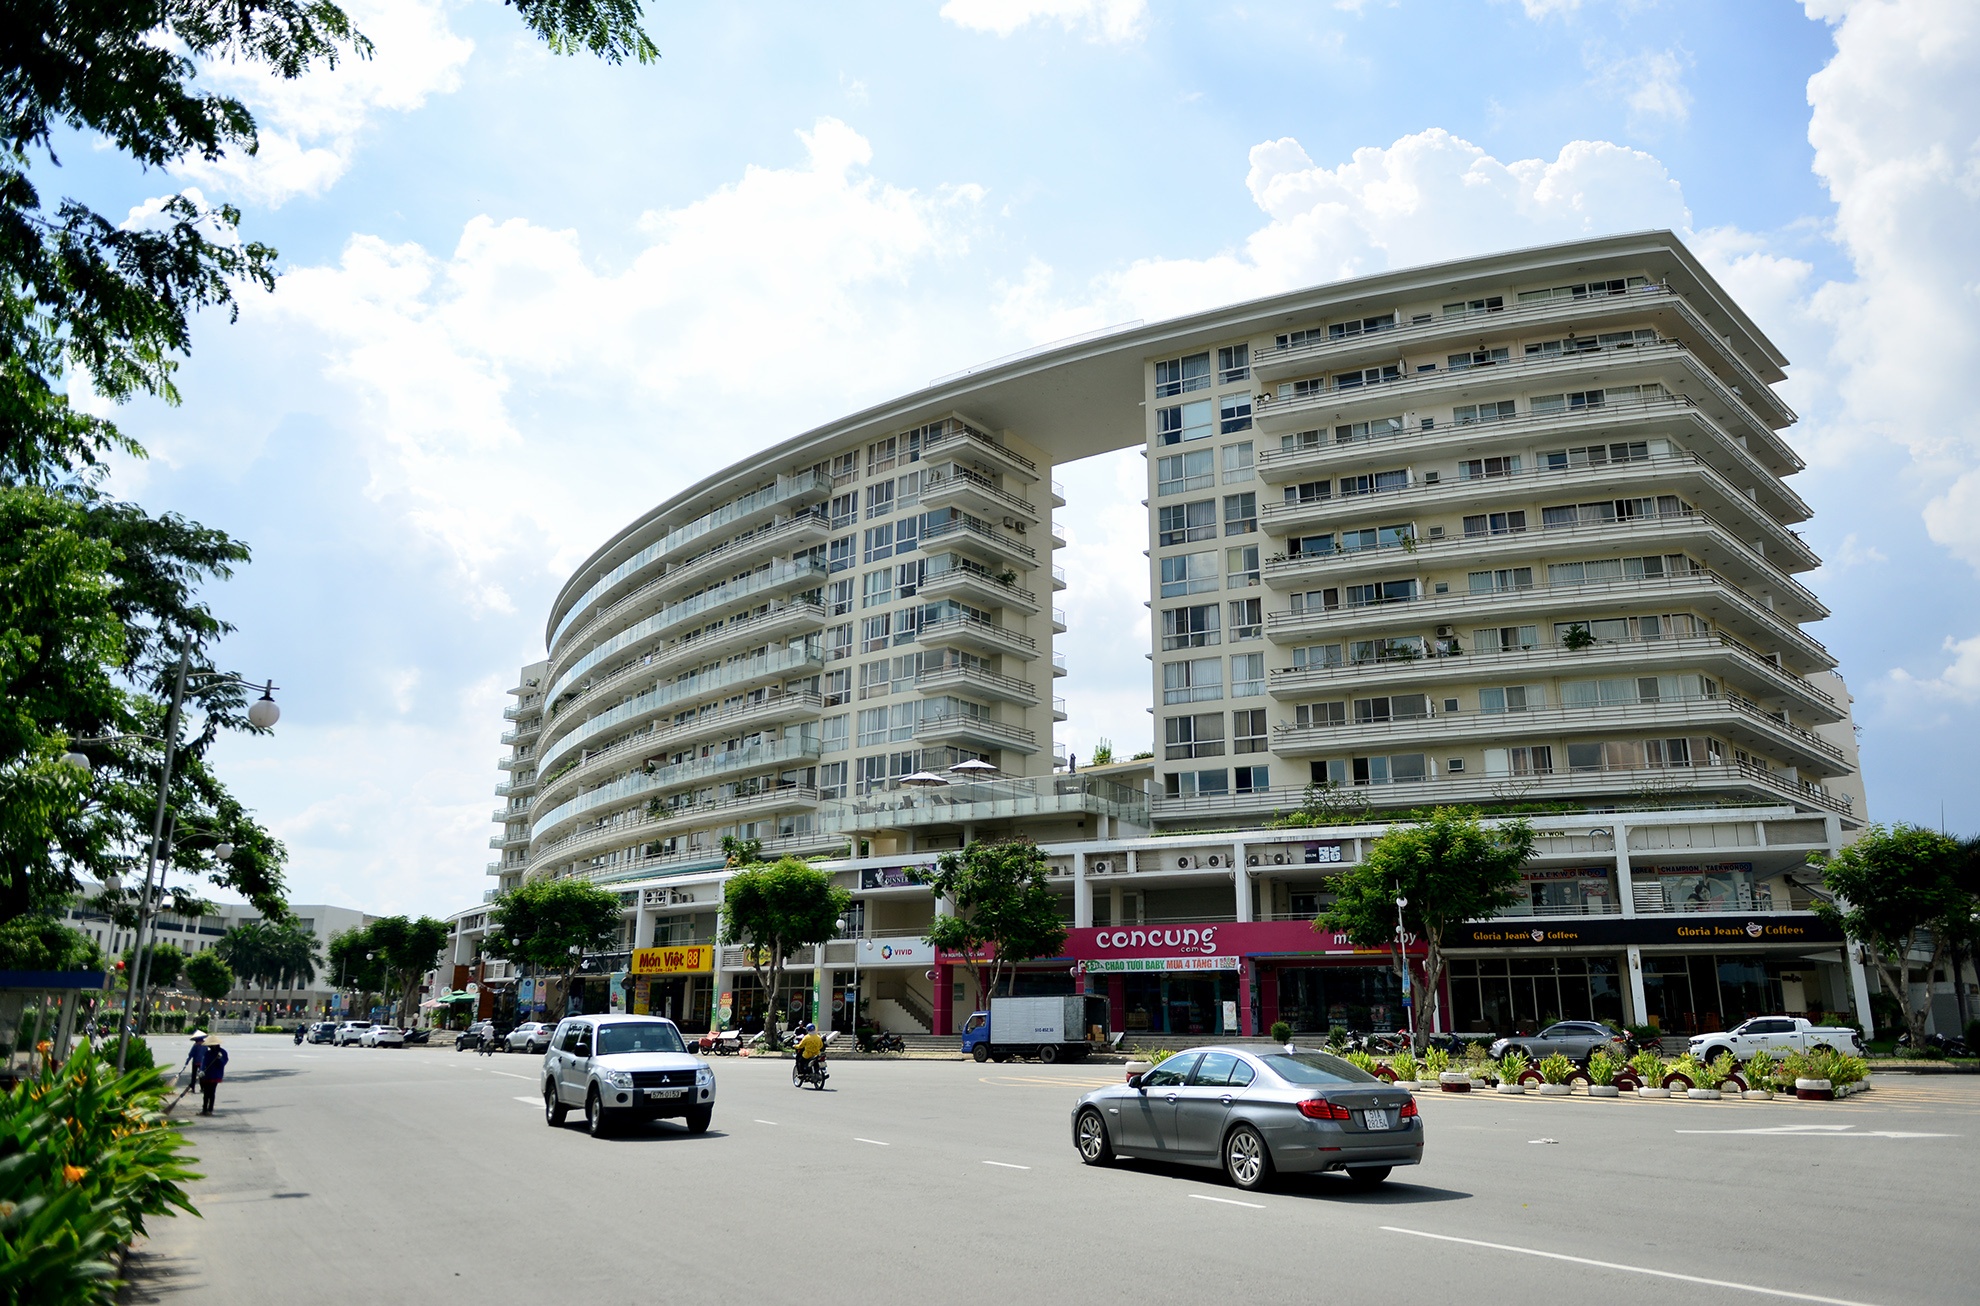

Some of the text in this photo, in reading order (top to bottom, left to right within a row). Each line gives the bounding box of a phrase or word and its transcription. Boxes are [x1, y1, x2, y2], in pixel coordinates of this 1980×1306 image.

[1660, 865, 1700, 873] CHAMPION
[1705, 863, 1750, 872] TAEKWONDO
[1533, 870, 1601, 878] TAEKWONDO
[1677, 924, 1805, 937] Gloria Jean's Coffees
[1473, 931, 1578, 941] Gloria Jean's Coffees
[894, 948, 913, 956] VIVID
[639, 950, 699, 971] Món Việt 88
[1166, 960, 1183, 969] MUA
[1184, 959, 1190, 969] 4
